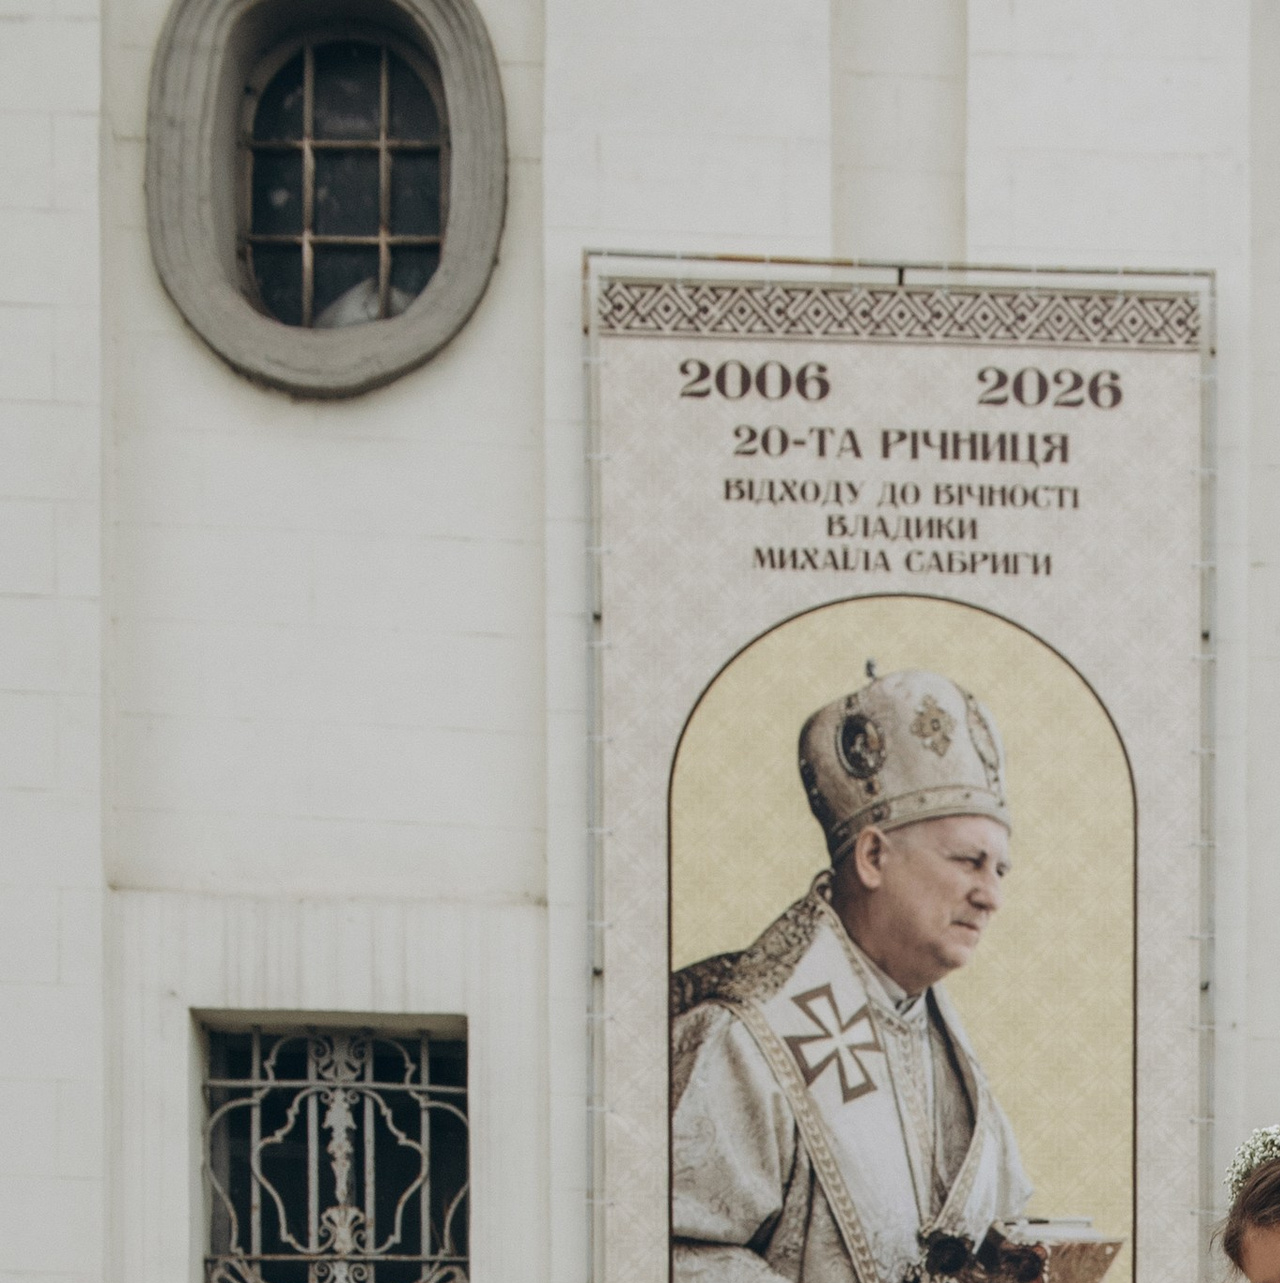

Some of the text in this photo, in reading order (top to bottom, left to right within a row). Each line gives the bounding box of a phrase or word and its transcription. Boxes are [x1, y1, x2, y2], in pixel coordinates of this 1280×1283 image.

[679, 359, 1124, 409] 2006 2026
[733, 425, 1070, 467] 20-ТА РІЧНИЦЯ
[723, 478, 1080, 510] ВІДХОДУ ДО ВІЧНОСТІ
[826, 515, 978, 541] ВЛАДИКИ
[752, 545, 1053, 577] МИХАЇЛА САБРИГИ
